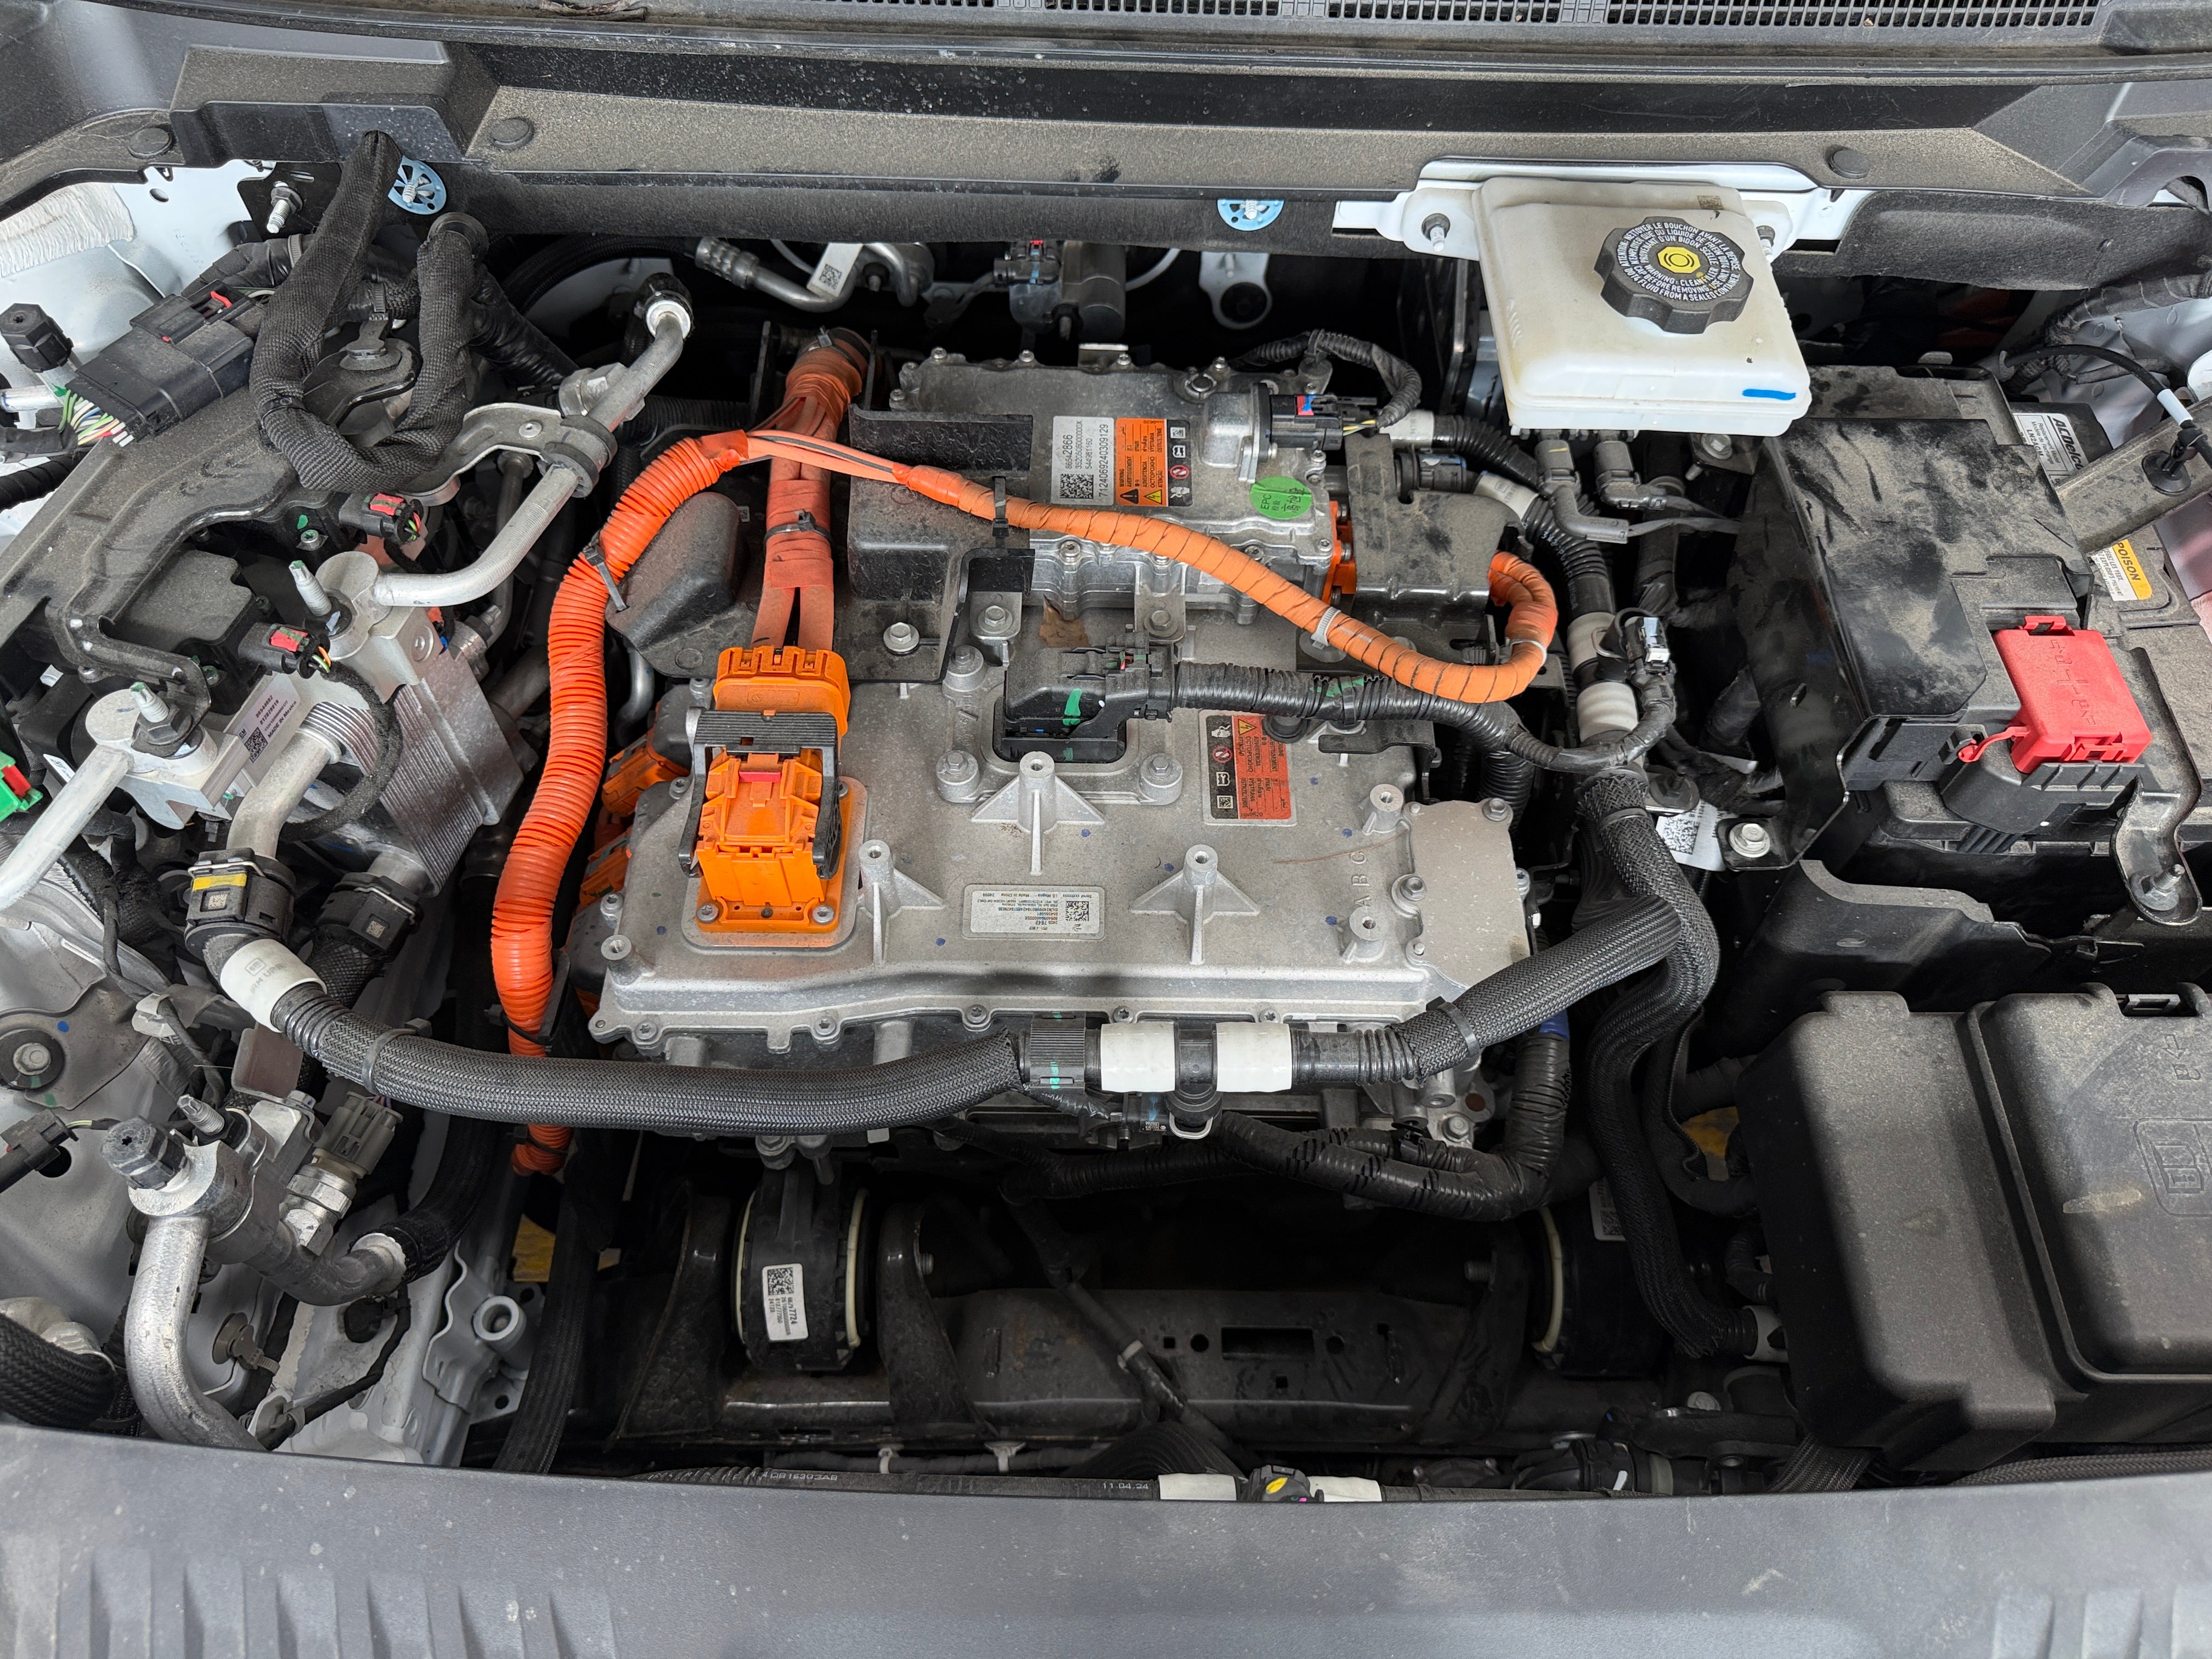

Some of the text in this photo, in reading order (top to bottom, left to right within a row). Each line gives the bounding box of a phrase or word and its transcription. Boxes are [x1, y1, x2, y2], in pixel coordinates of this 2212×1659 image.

[1623, 224, 1654, 241] NETTOYER
[1664, 222, 1699, 234] BOUCHON
[1699, 231, 1722, 245] AVANT
[1719, 244, 1730, 252] LA
[1639, 237, 1659, 263] PROVENANT
[1678, 237, 1701, 249] BIDON
[1640, 231, 1655, 240] QUE
[1667, 229, 1695, 239] LIQUIDE
[1695, 235, 1706, 244] DE
[1705, 241, 1723, 256] FREIN
[1634, 266, 1647, 275] CAP
[1644, 274, 1672, 290] BEFORE
[1708, 279, 1723, 290] USE
[1717, 268, 1730, 282] ONLY
[1637, 278, 1660, 293] FLUID
[1659, 288, 1681, 300] FROM
[1689, 291, 1717, 301] SEALED
[1680, 278, 1705, 286] CLEAN
[1701, 267, 1719, 283] FILLER
[2051, 451, 2061, 464] Model
[2052, 418, 2086, 471] ACDelco
[1098, 424, 1109, 498] 7124069240309129
[1260, 493, 1272, 510] EPC
[2115, 542, 2141, 581] POISON
[267, 723, 280, 738] MADE
[283, 701, 297, 718] Mexico
[1349, 850, 1371, 907] A B C
